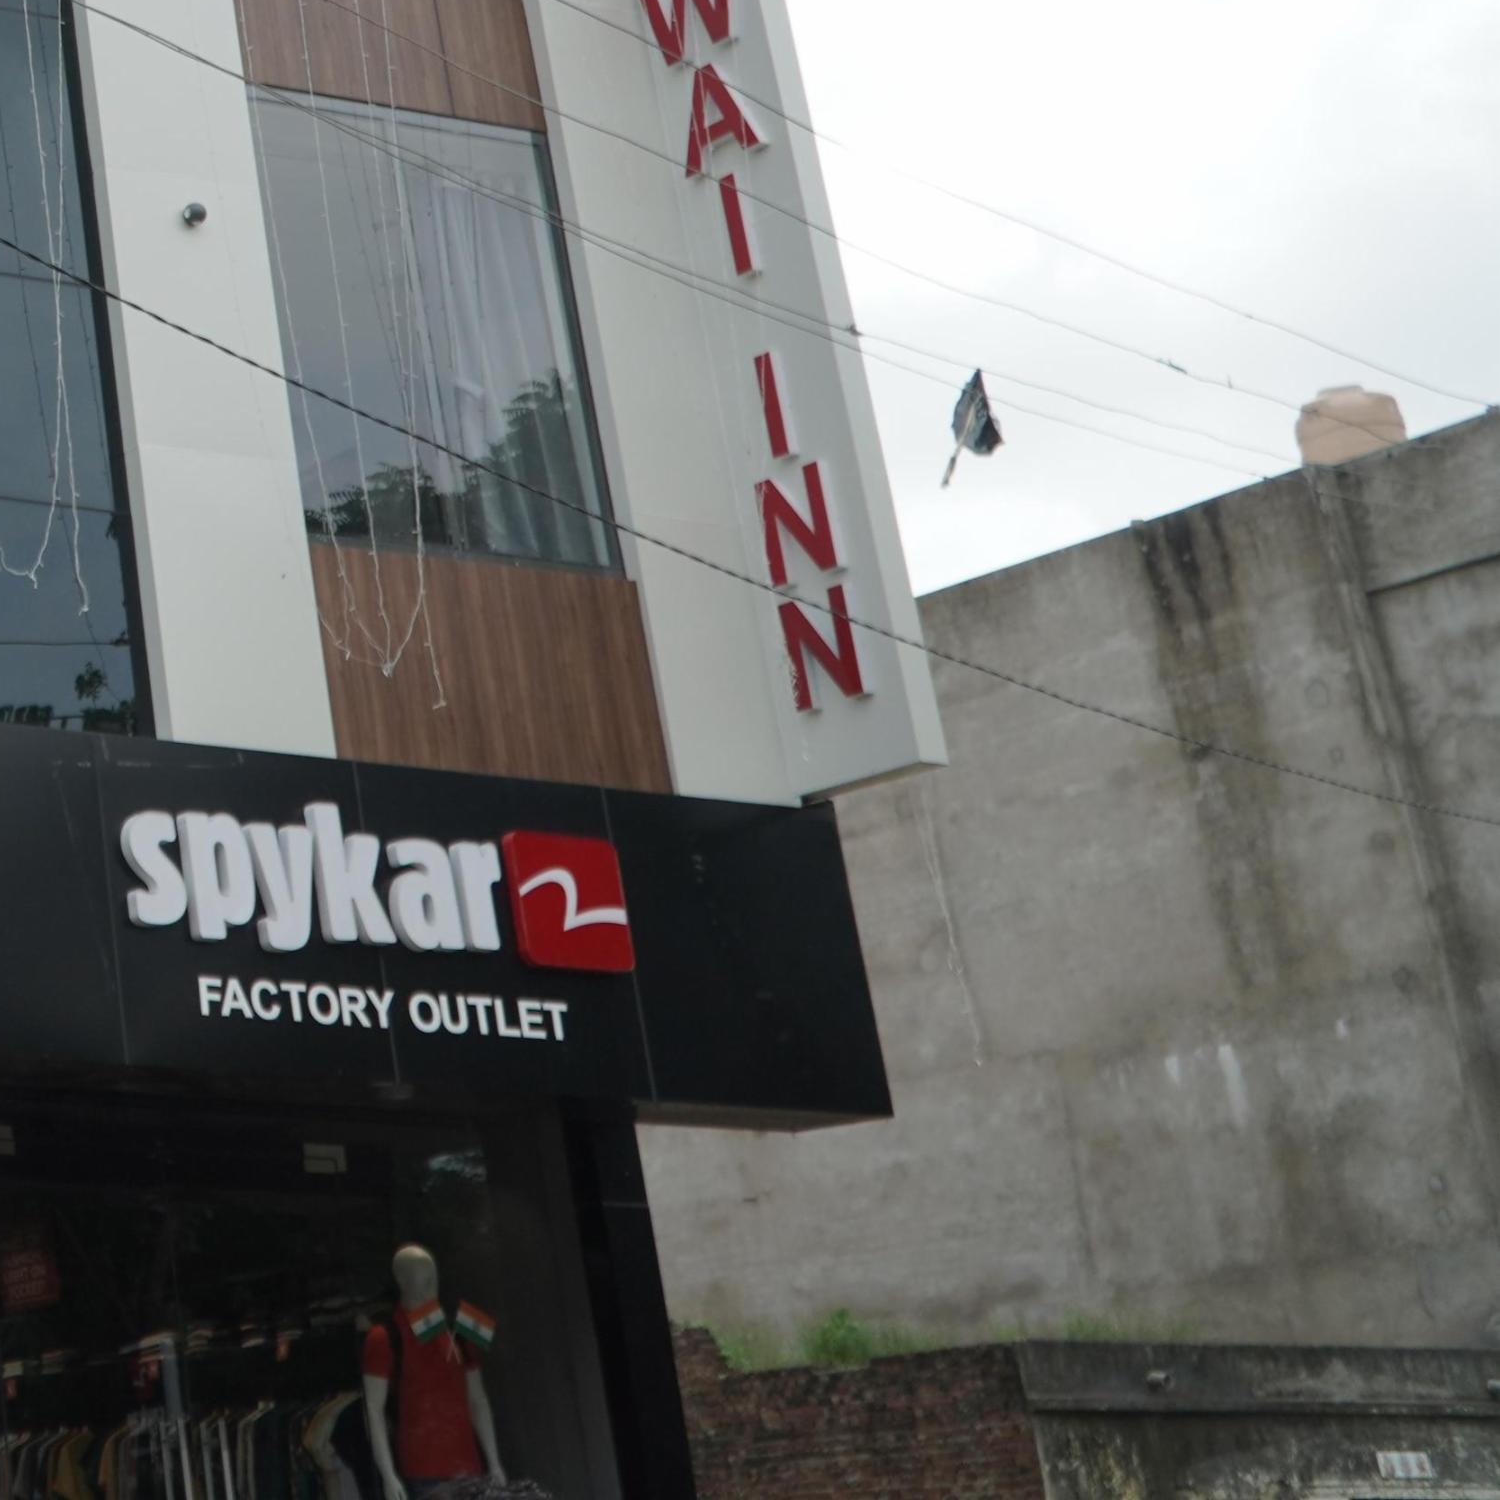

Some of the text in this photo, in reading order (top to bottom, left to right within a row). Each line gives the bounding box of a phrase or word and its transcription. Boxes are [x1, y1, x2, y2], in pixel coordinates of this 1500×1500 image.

[753, 350, 866, 713] INN
[120, 801, 502, 953] spykar
[197, 975, 569, 1042] FACTORY OUTLET
